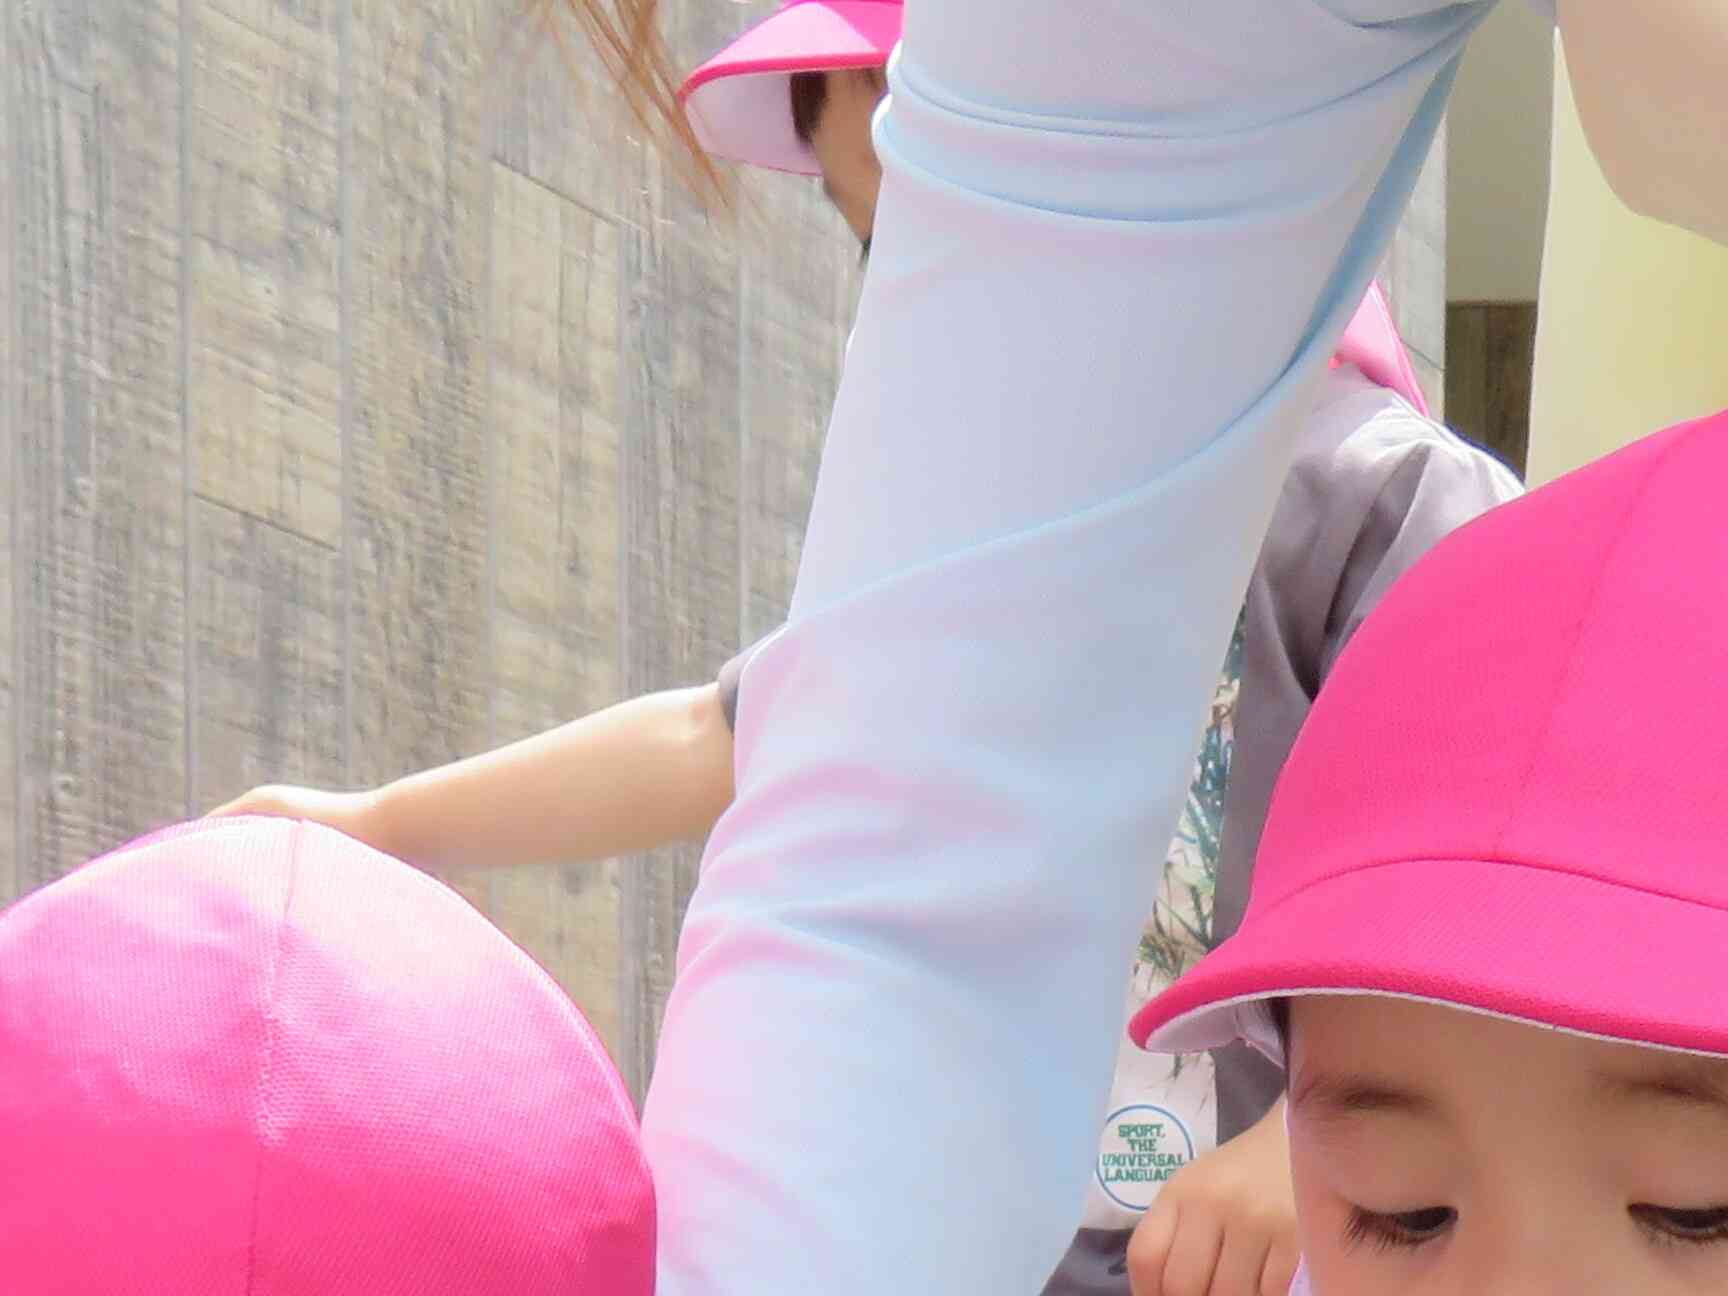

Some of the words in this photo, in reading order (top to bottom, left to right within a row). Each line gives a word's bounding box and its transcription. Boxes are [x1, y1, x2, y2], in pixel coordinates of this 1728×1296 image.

[1127, 1138, 1157, 1152] THE
[1102, 1153, 1186, 1168] UNIVERSAL
[1103, 1168, 1176, 1182] LANGUA
